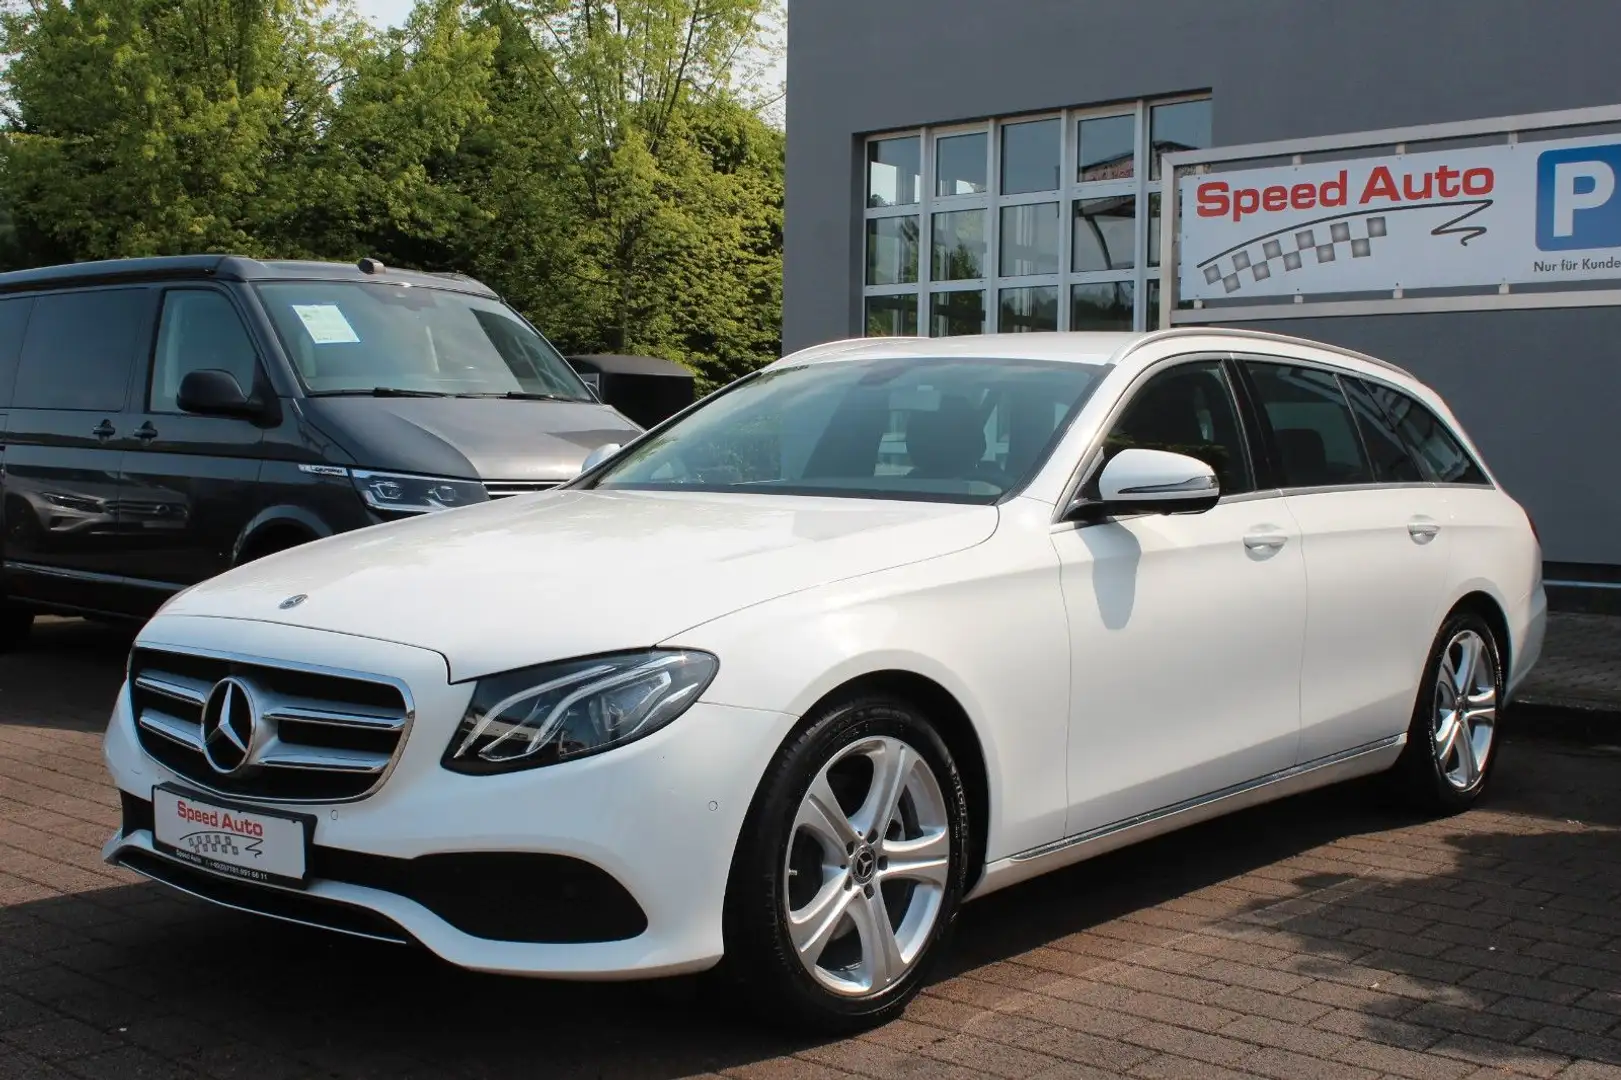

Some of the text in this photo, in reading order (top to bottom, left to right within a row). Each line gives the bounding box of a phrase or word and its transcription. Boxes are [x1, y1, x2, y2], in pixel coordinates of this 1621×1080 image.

[1196, 164, 1494, 221] Speed Auto
[1553, 159, 1615, 237] P
[1533, 261, 1557, 272] Nur
[1561, 259, 1578, 271] für
[177, 800, 263, 837] Speed Auto
